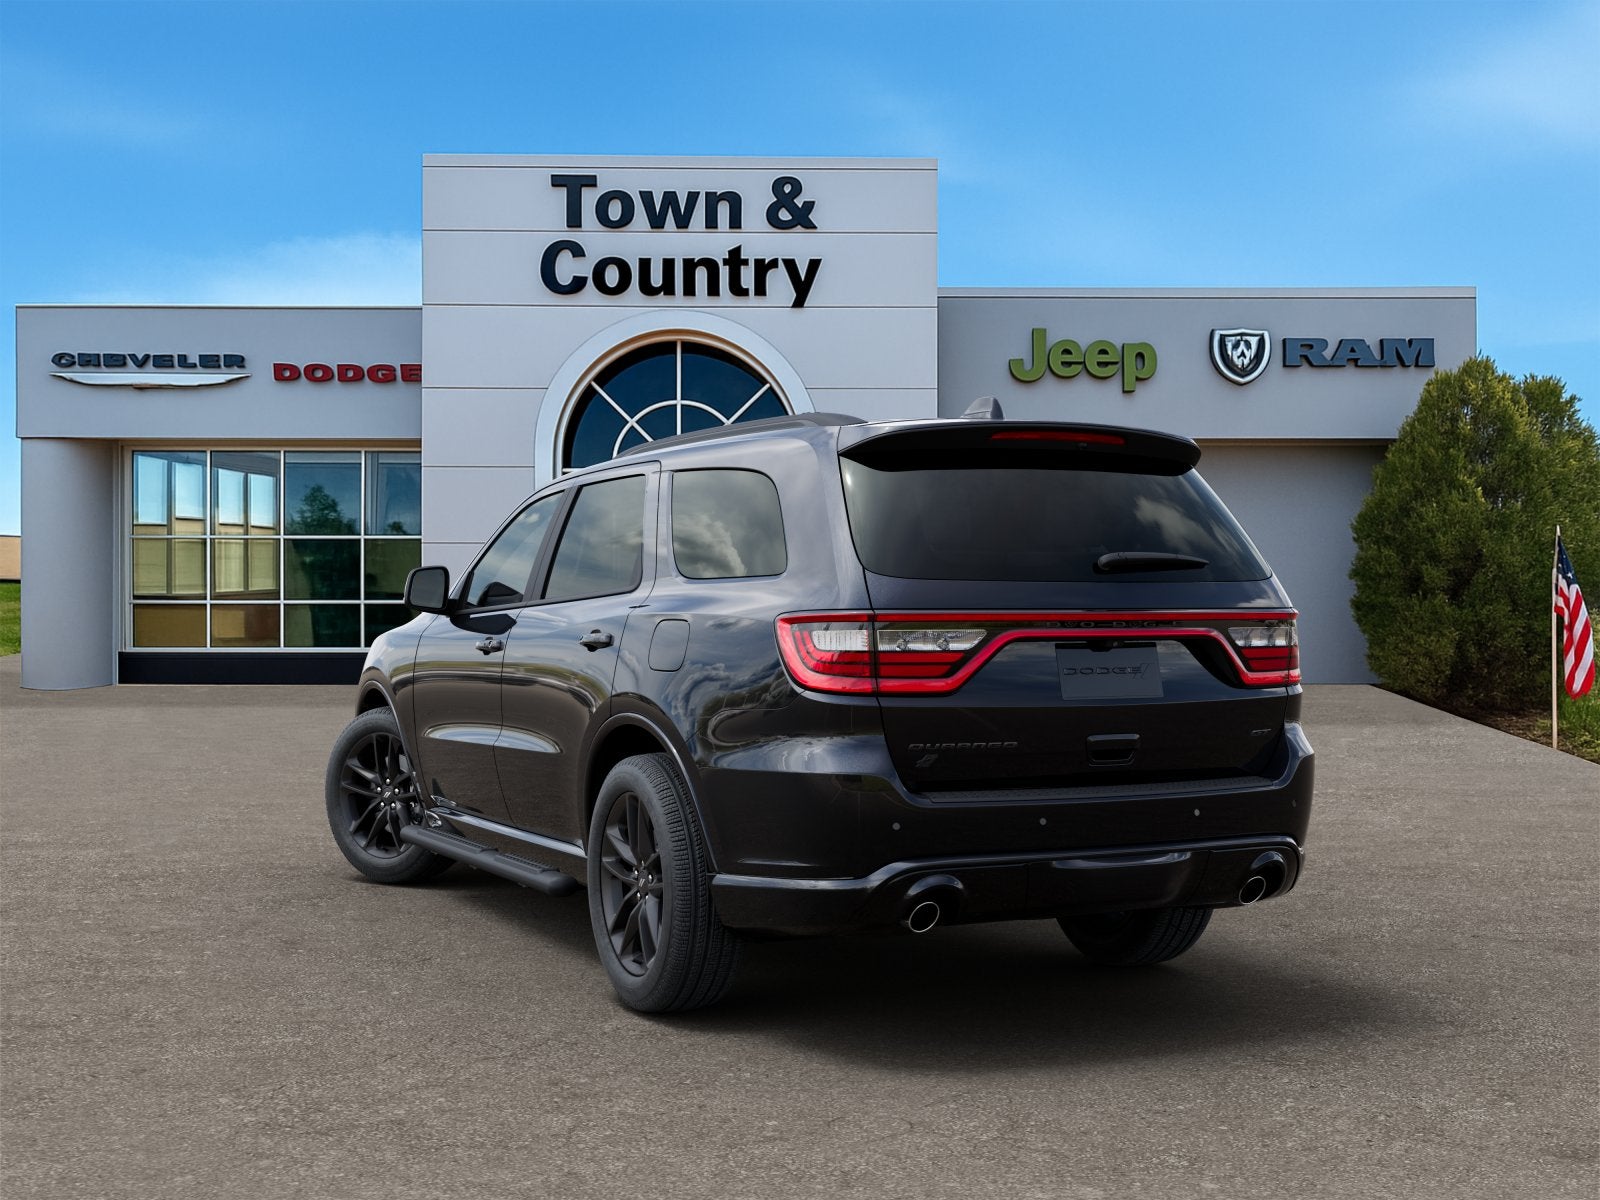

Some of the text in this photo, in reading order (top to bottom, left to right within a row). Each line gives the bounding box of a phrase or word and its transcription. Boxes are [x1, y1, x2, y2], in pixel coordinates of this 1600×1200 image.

[550, 174, 818, 230] Town &
[540, 239, 822, 308] Country
[273, 363, 422, 383] DODGE
[1008, 327, 1158, 393] Jeep
[1282, 337, 1436, 368] RAM
